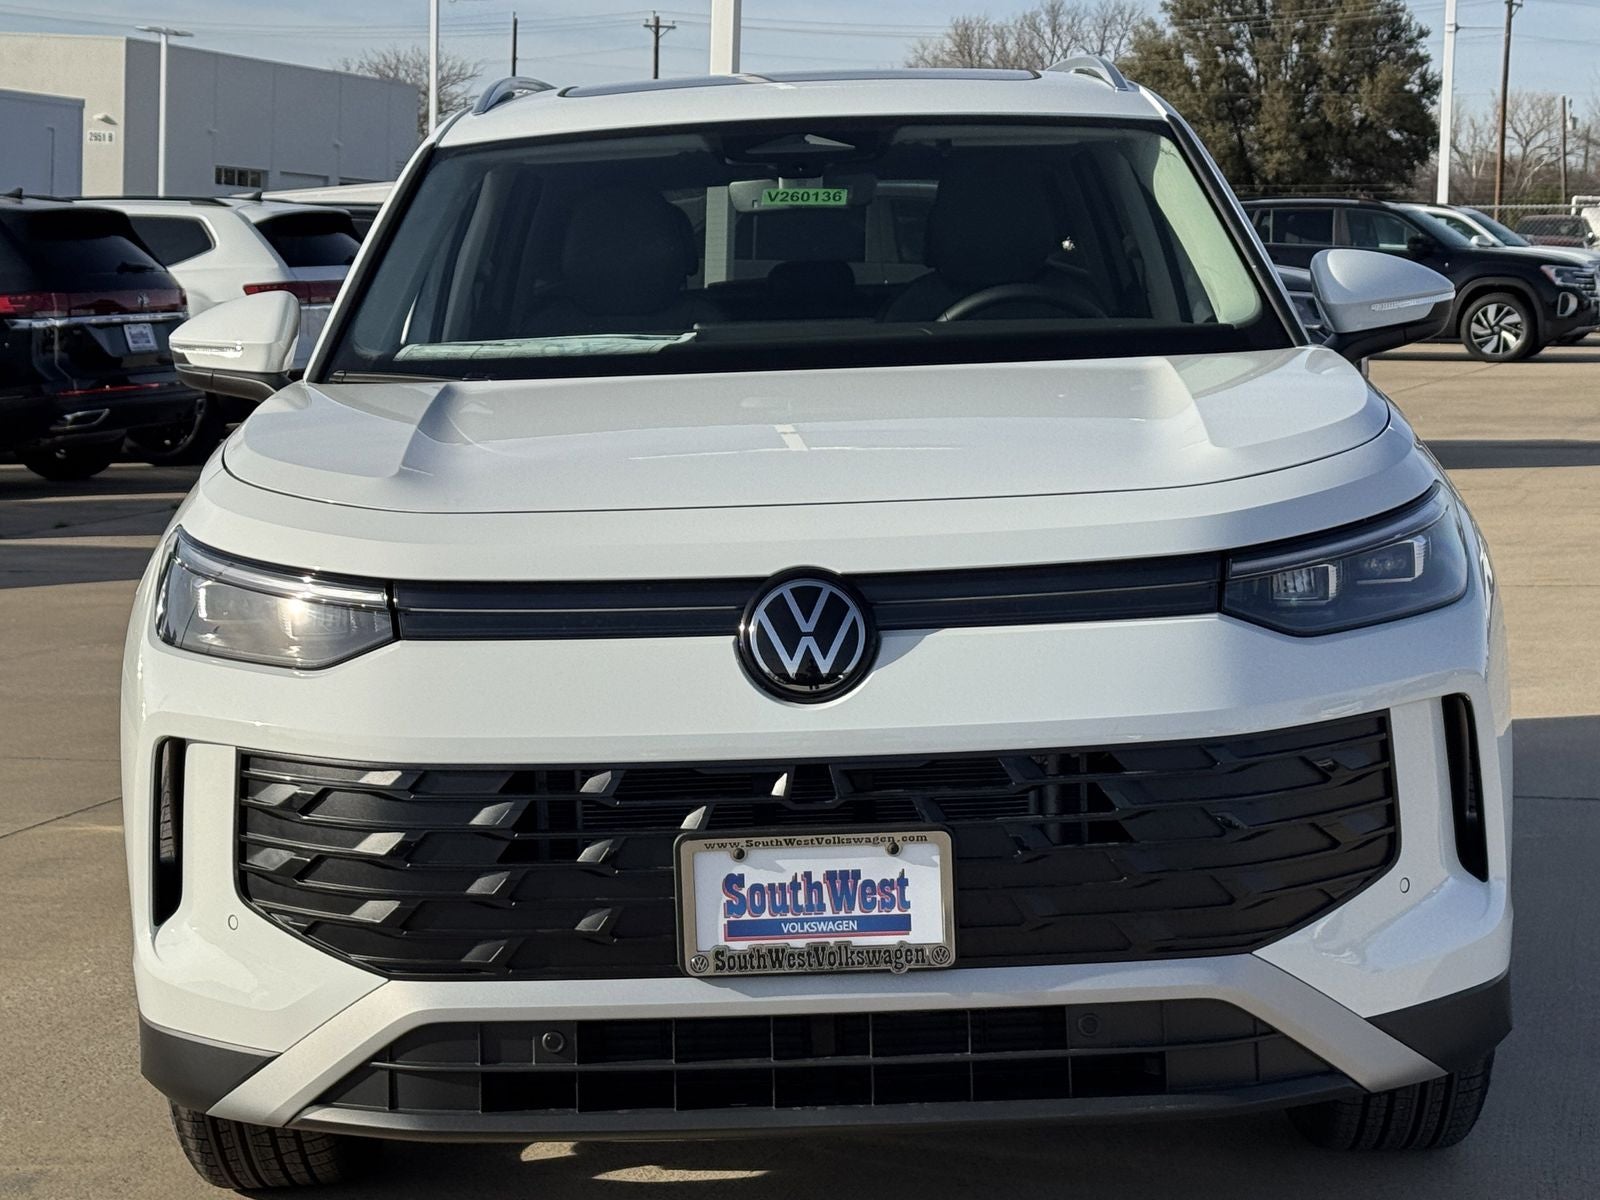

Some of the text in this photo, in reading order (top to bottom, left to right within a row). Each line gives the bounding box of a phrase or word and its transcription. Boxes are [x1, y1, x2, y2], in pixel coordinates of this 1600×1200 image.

[767, 191, 842, 203] V260136
[704, 834, 928, 849] www.SouthWestVolkswagen.com
[781, 921, 858, 934] VOLKSWAGEN
[714, 945, 926, 970] SouthWestVolkswagen
